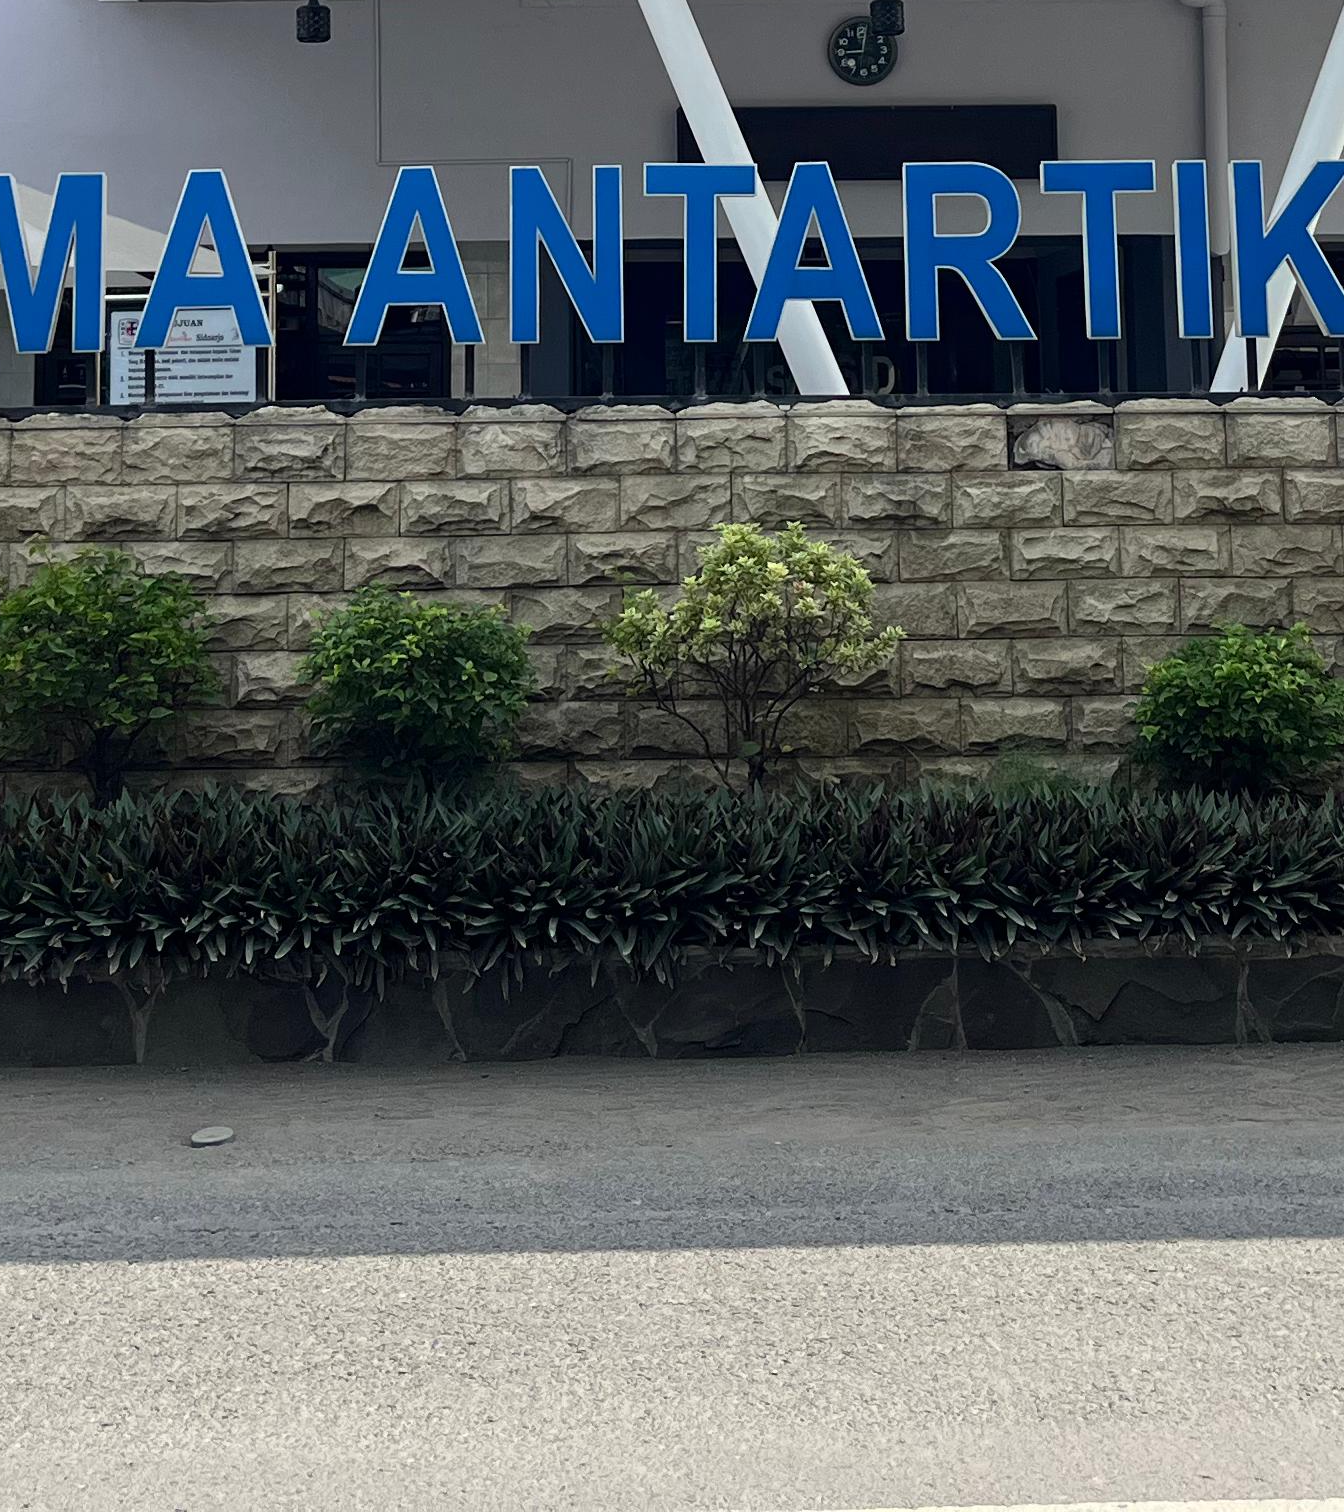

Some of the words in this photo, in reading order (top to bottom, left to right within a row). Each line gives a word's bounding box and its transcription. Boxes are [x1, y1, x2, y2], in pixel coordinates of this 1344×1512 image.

[839, 38, 849, 46] 10
[877, 35, 884, 44] 2
[880, 45, 888, 54] 3
[878, 56, 887, 65] 4
